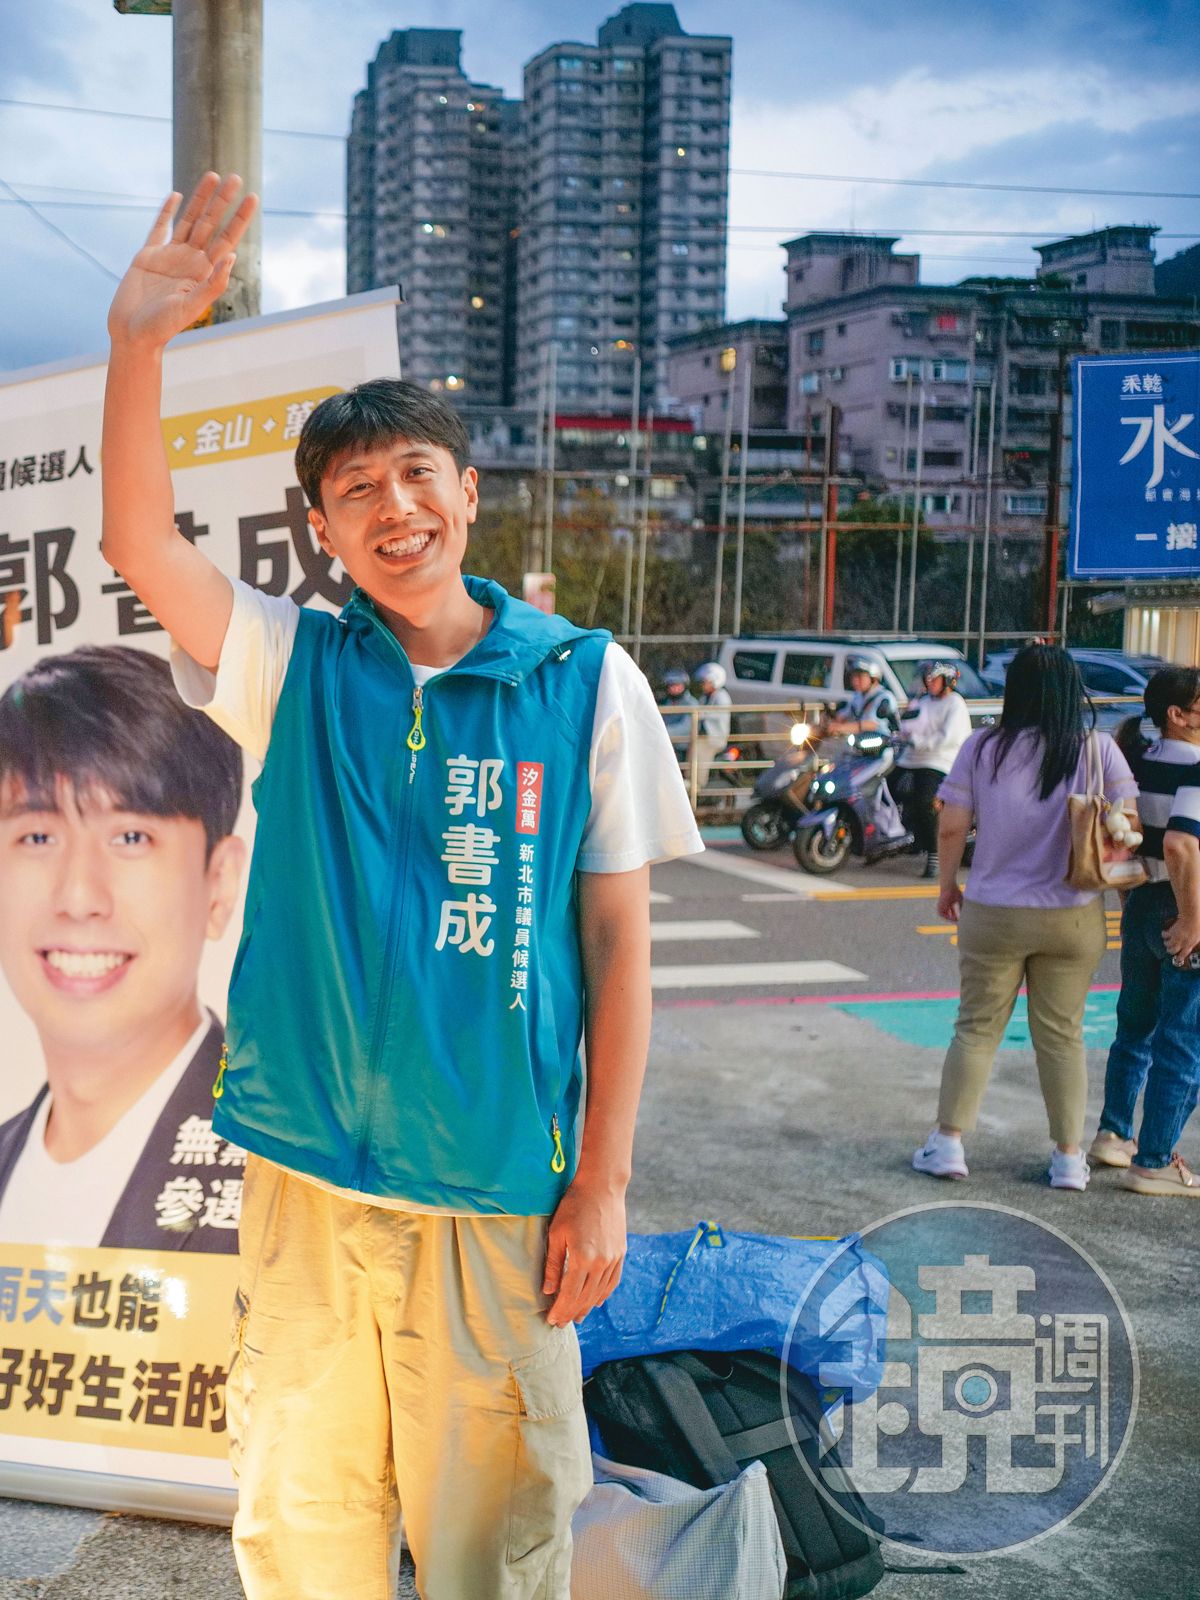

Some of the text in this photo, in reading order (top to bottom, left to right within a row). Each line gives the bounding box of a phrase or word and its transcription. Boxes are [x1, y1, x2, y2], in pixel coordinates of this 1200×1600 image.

[193, 398, 328, 456] 金山 萬
[1119, 404, 1200, 489] 水
[520, 767, 539, 829] 汐金萬
[435, 754, 504, 957] 郭書成
[509, 843, 535, 1011] 新北市議員候選人
[155, 1176, 243, 1231] 參選
